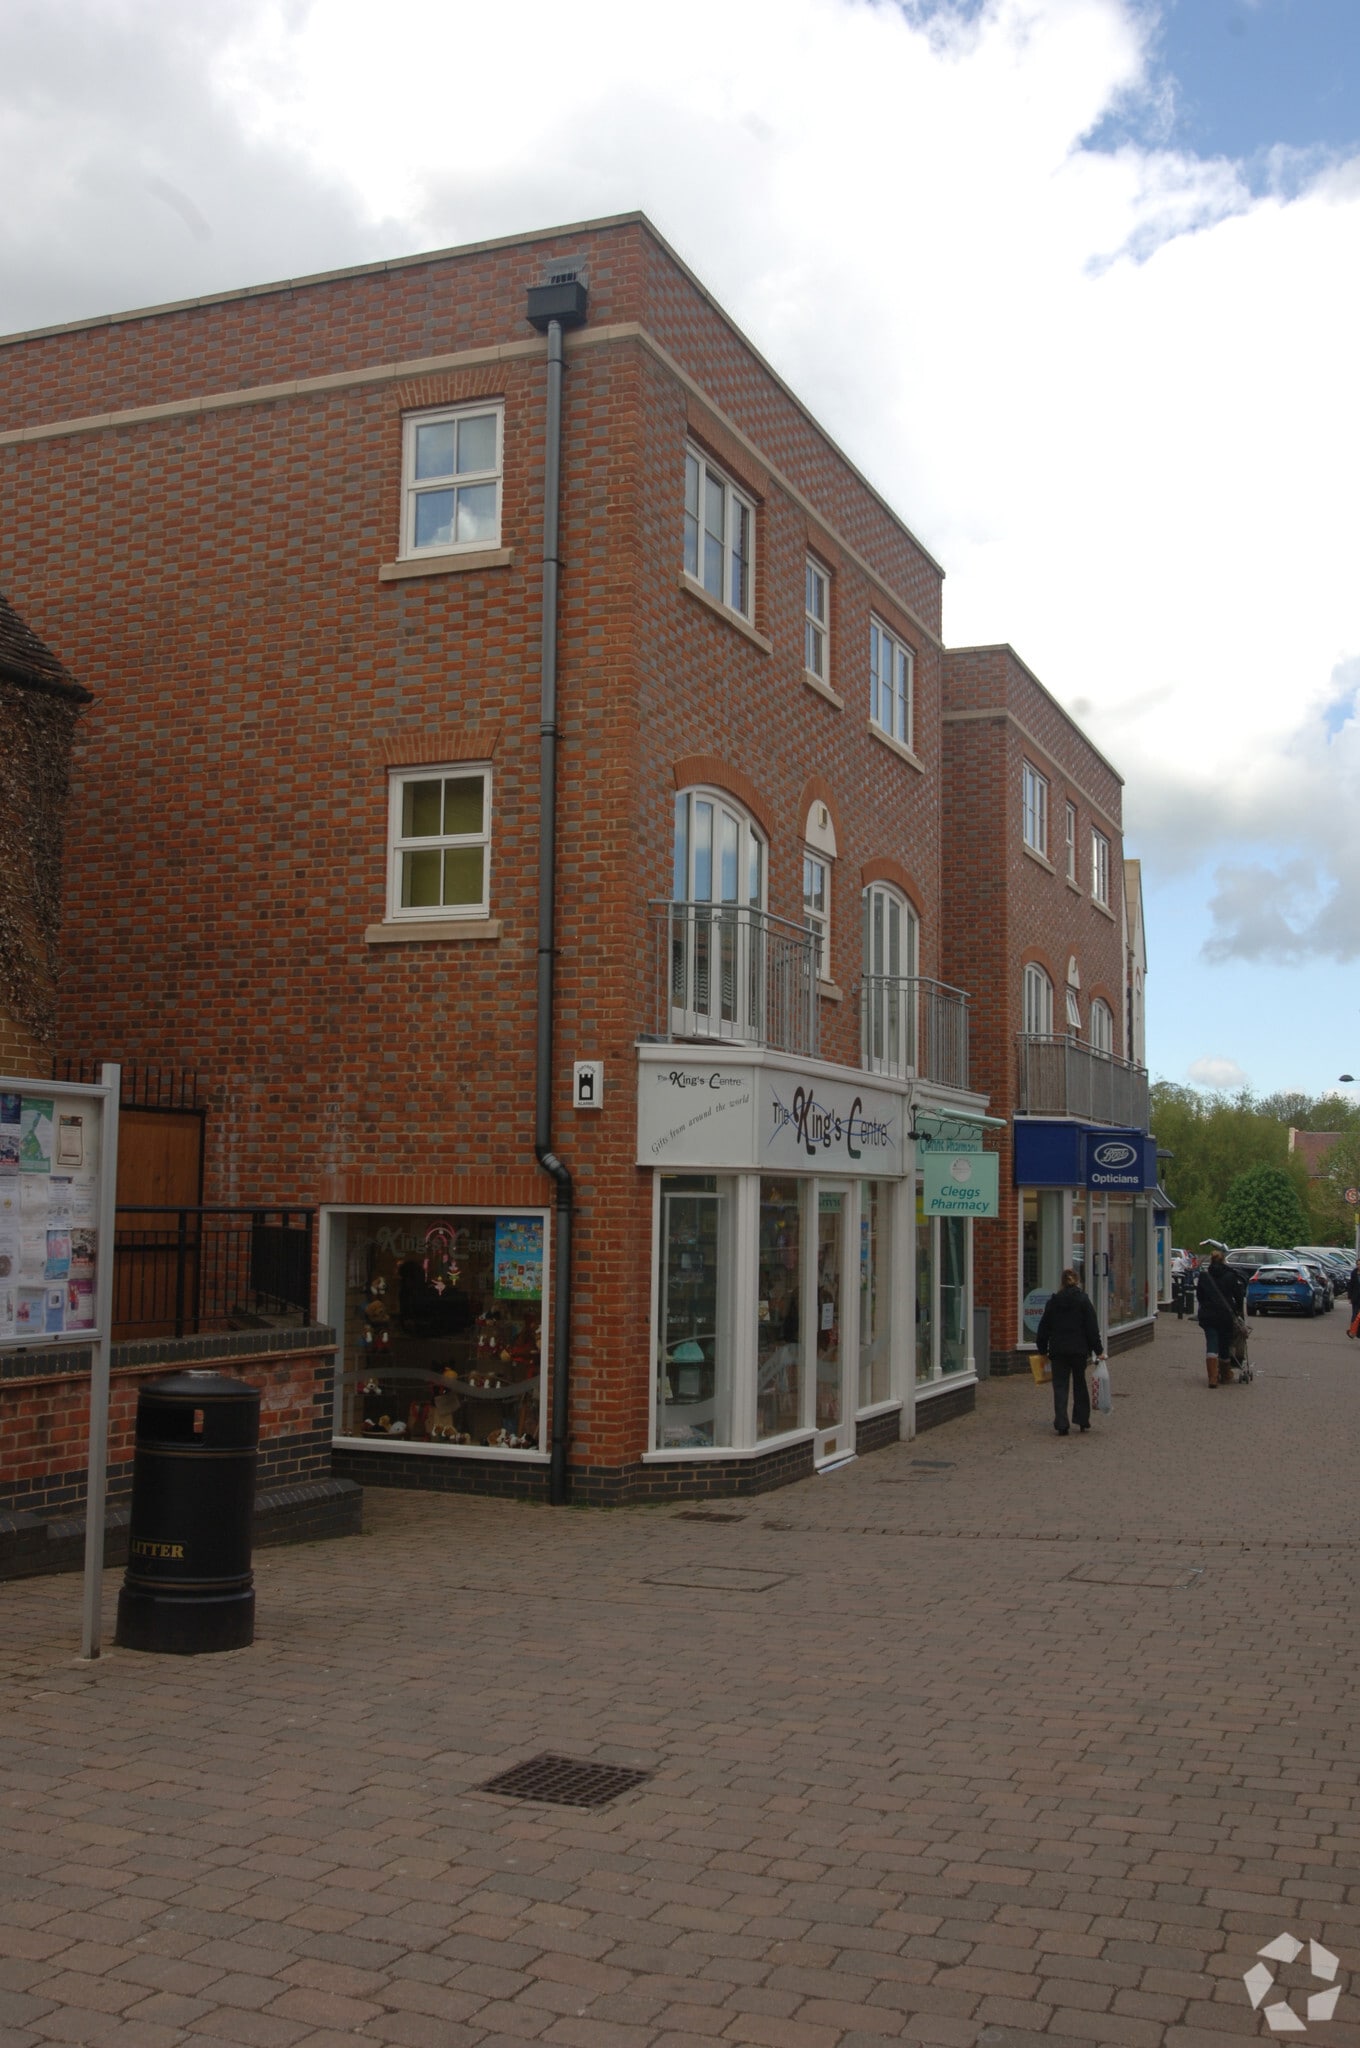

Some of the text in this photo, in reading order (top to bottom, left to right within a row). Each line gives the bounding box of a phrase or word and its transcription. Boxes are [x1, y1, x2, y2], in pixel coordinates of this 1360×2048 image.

[669, 1071, 705, 1088] King's
[709, 1072, 742, 1089] Centre
[651, 1094, 750, 1156] Gifts from around the world
[772, 1086, 888, 1160] The King's Centre
[1100, 1147, 1130, 1163] Boots
[1091, 1173, 1139, 1185] Opticians
[940, 1186, 981, 1199] Cleggs
[930, 1199, 990, 1213] Pharmacy
